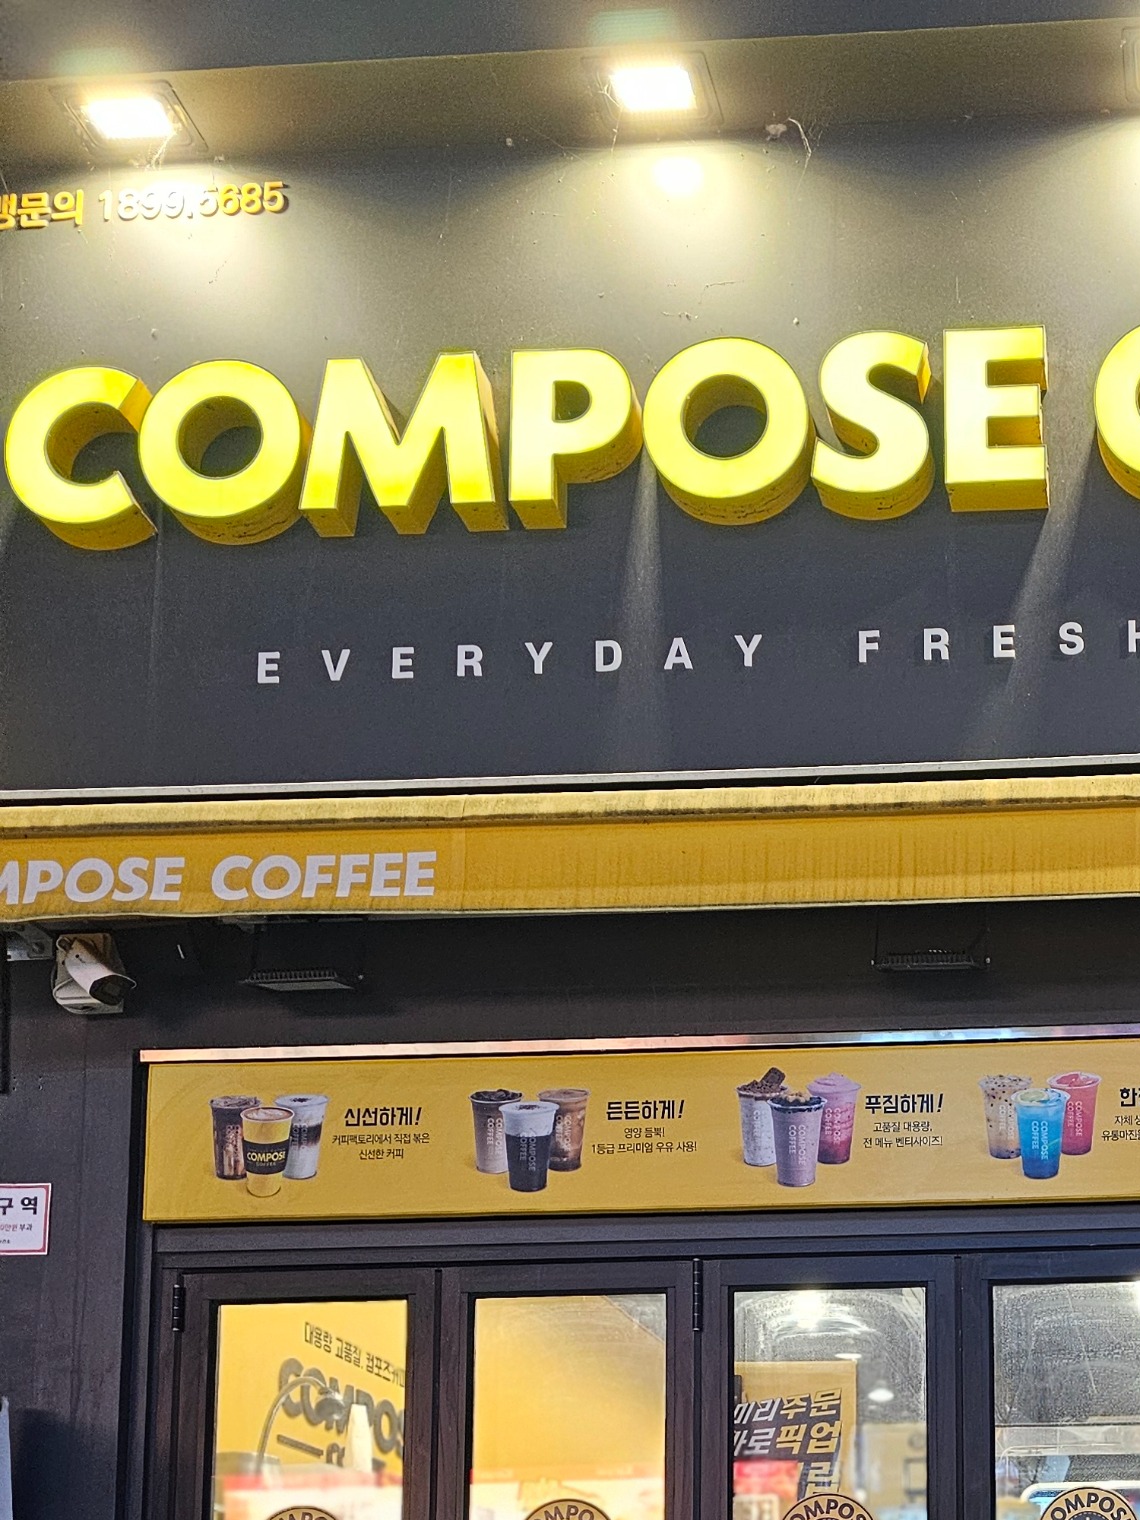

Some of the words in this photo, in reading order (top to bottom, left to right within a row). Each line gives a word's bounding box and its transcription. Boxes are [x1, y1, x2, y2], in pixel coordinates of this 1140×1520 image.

[4, 324, 1050, 552] COMPOSE
[256, 633, 765, 685] EVERYDAY
[211, 850, 437, 901] COFFEE
[606, 1099, 685, 1121] 든든하게!
[864, 1093, 944, 1115] 푸짐하게!
[344, 1106, 422, 1127] 신선하게!
[1114, 1114, 1133, 1127] 자체
[624, 1126, 642, 1139] 영양
[873, 1122, 901, 1133] 고품질
[1031, 1120, 1040, 1150] COFFEE
[591, 1143, 615, 1155] 1등급
[617, 1142, 654, 1154] 프리미엄
[656, 1141, 674, 1153] 우유
[863, 1137, 873, 1148] 전
[874, 1136, 893, 1148] 메뉴
[359, 1148, 385, 1160] 신선한
[386, 1147, 405, 1159] 커피
